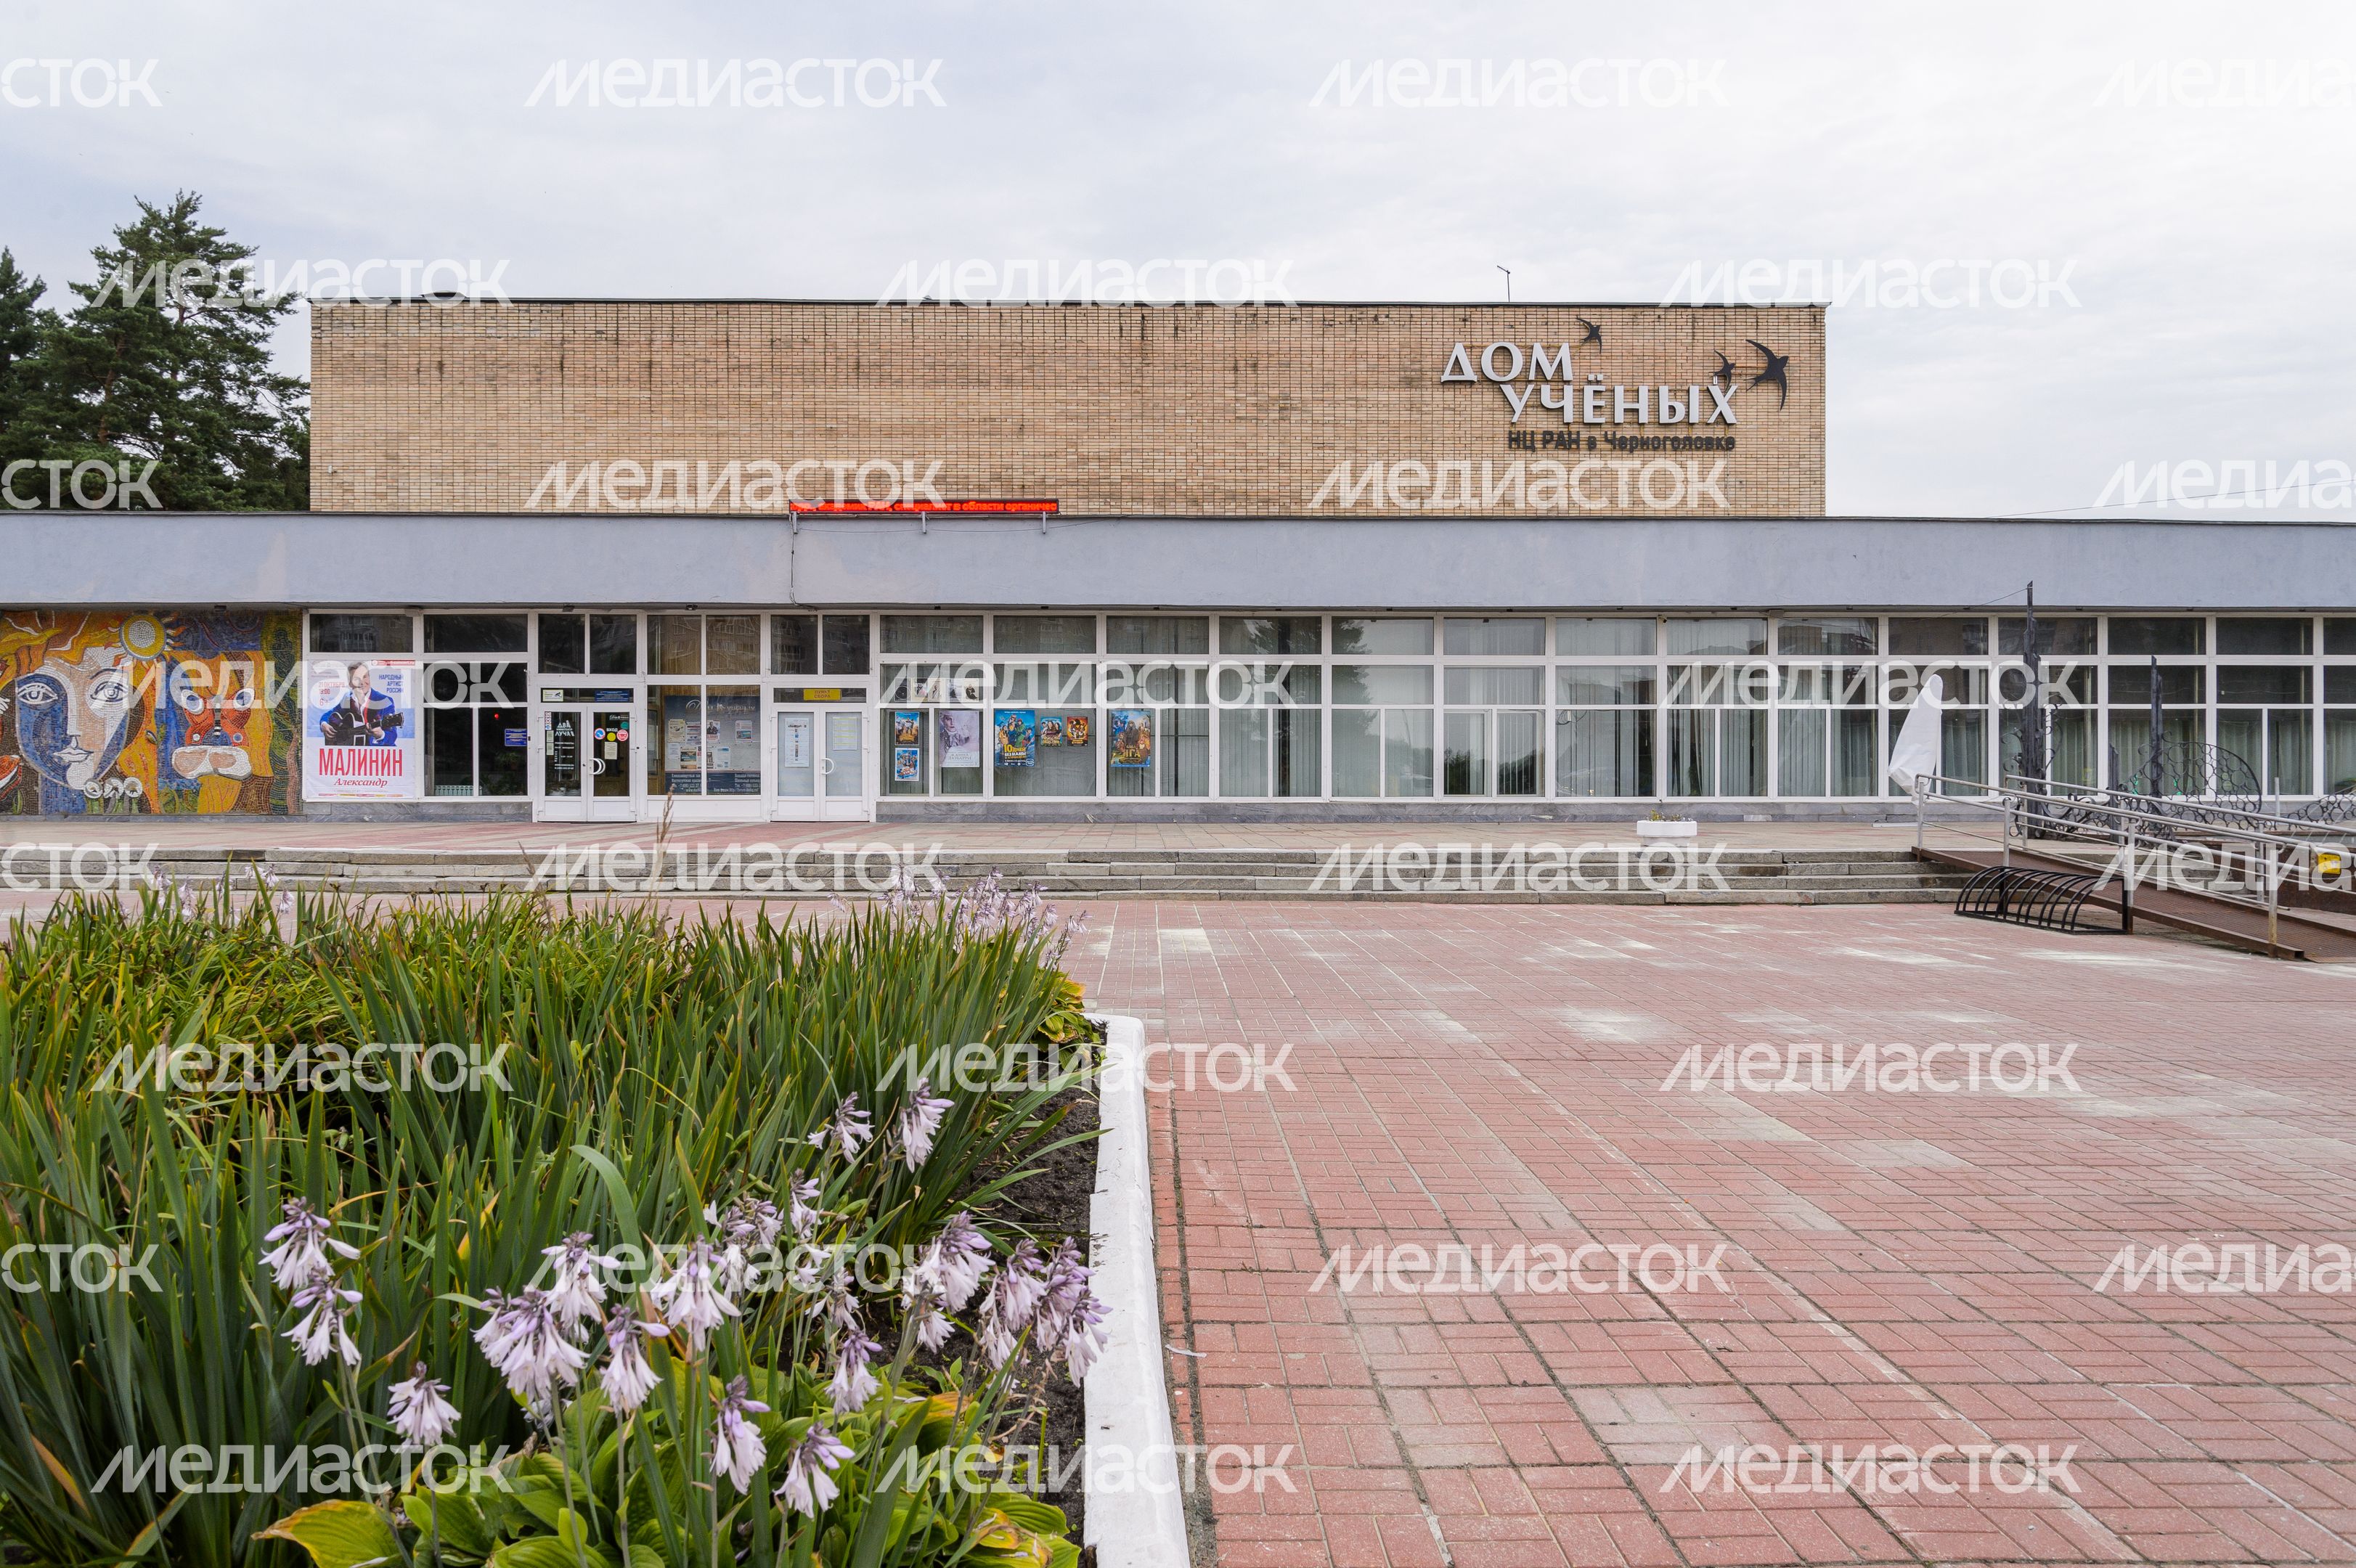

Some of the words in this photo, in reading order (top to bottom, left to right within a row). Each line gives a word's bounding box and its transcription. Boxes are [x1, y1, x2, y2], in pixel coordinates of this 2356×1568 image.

[1440, 342, 1574, 383] ДОМ
[1499, 374, 1738, 424] УЧЁНЫХ
[1508, 430, 1536, 452] НЦ
[1543, 430, 1581, 449] РАН
[1588, 436, 1597, 449] в
[1604, 431, 1736, 452] Черноголовке
[1004, 744, 1013, 753] 10
[319, 748, 403, 777] МАЛИНИН
[333, 778, 388, 788] Александр
